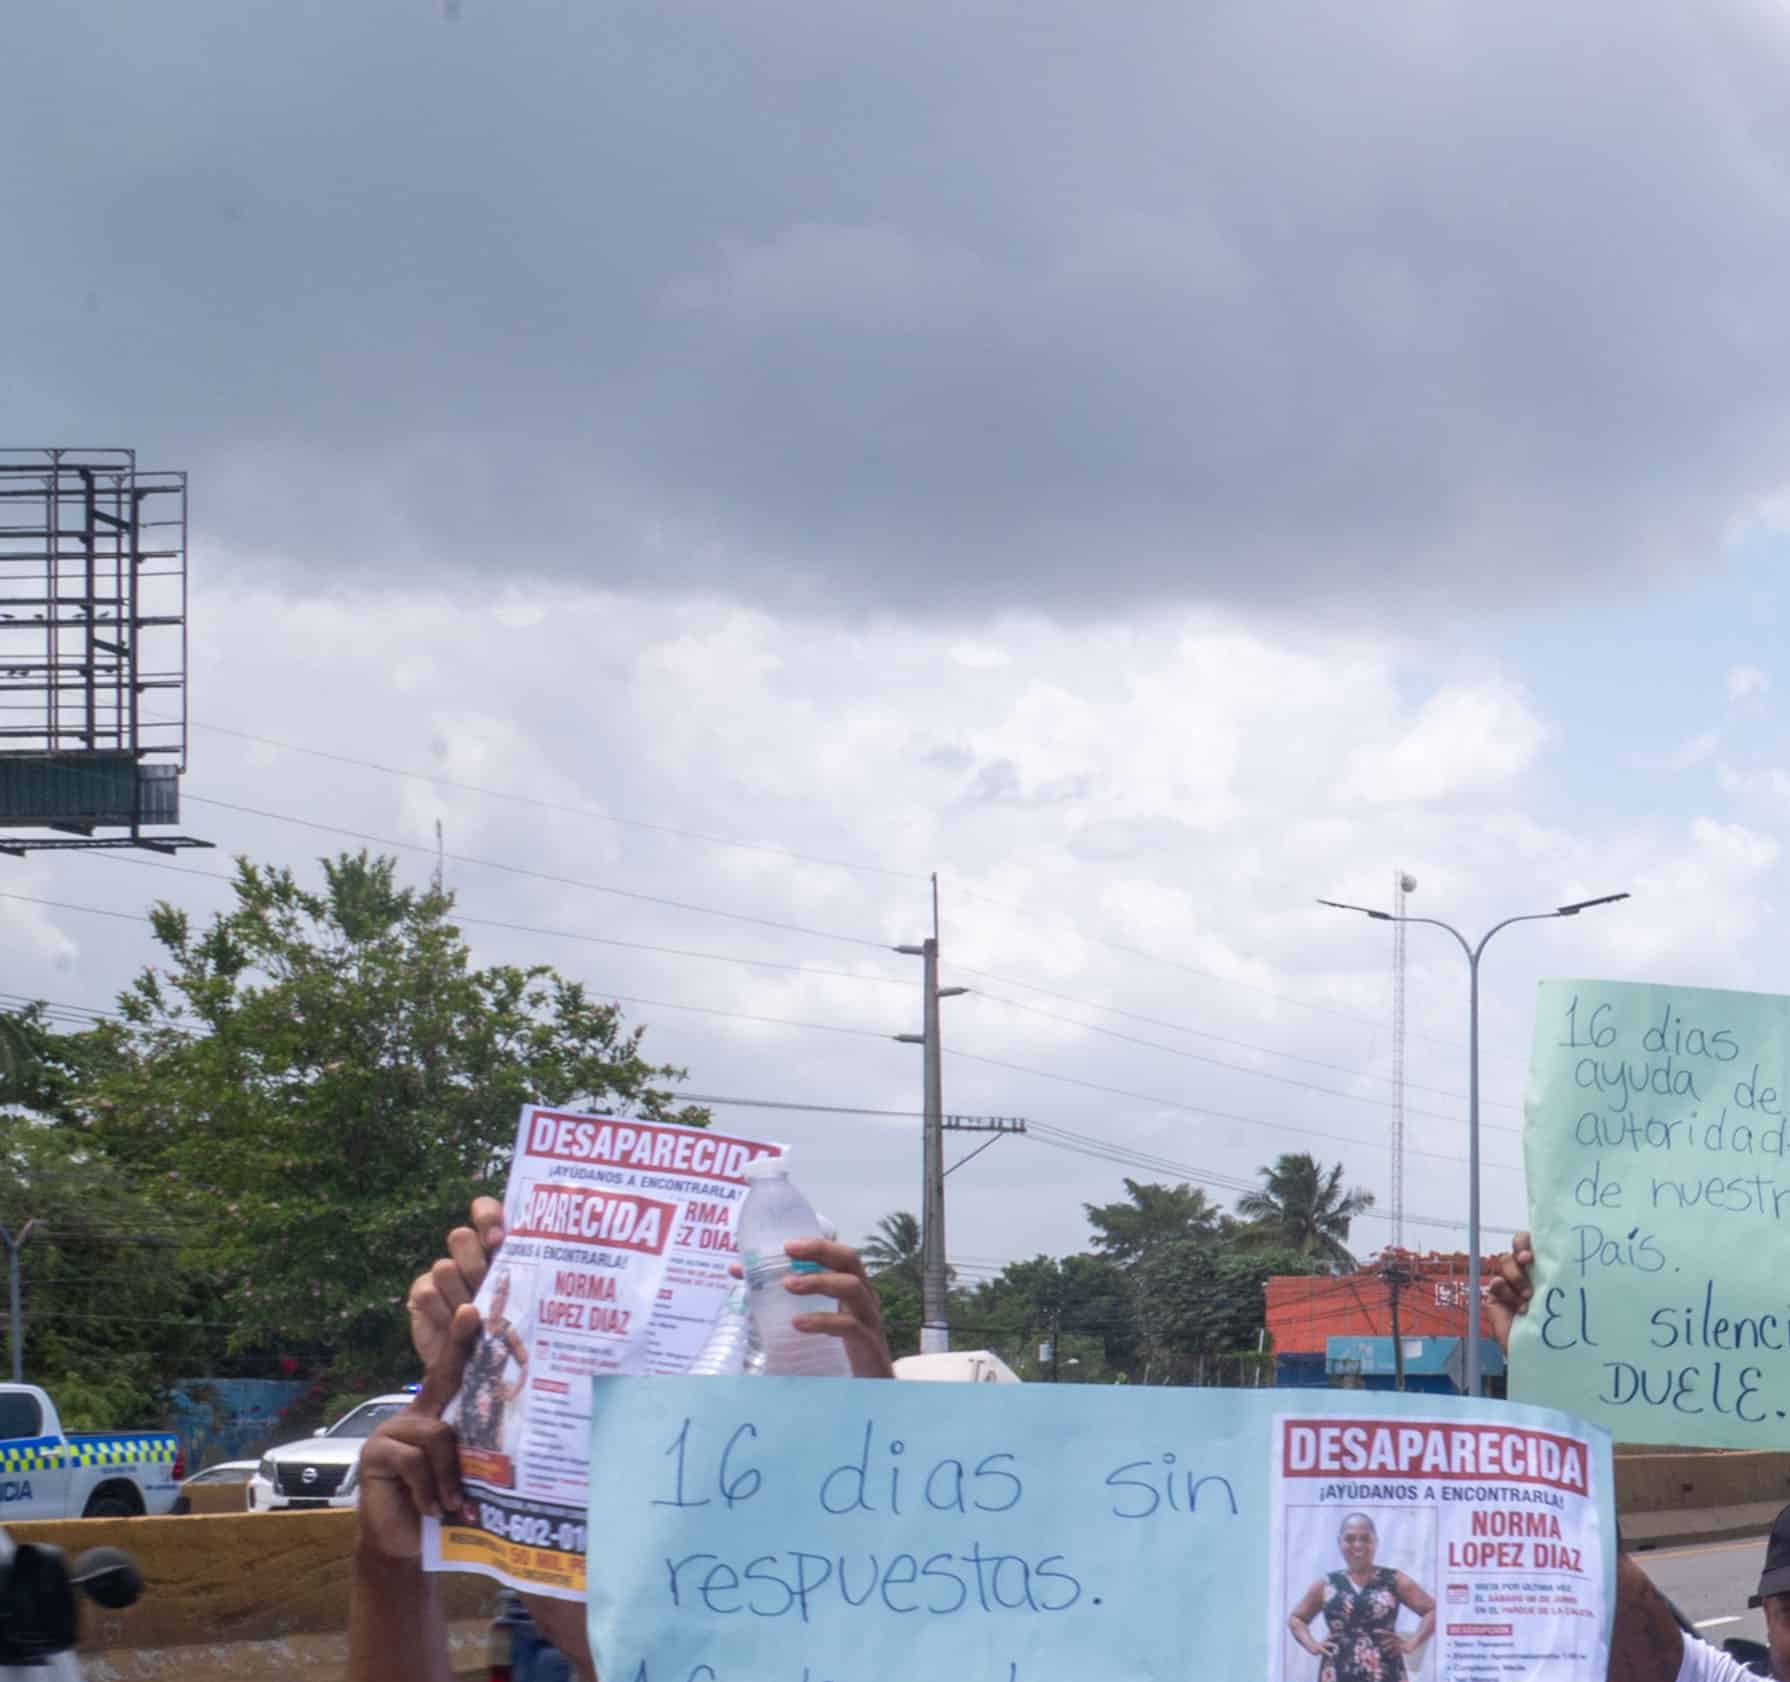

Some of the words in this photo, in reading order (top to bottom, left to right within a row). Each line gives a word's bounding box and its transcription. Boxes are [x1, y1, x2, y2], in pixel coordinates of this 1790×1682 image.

[1558, 994, 1616, 1048] 16
[1642, 1003, 1739, 1061] dias
[1575, 1056, 1701, 1112] ayuda
[1734, 1064, 1782, 1115] de
[531, 1116, 768, 1179] DESAPARECID
[1575, 1160, 1622, 1208] de
[555, 1270, 616, 1303] NORMA
[537, 1299, 583, 1328] LOPEZ
[589, 1306, 632, 1336] DIAZ
[1541, 1287, 1599, 1350] El
[650, 1417, 762, 1510] 16
[819, 1419, 1022, 1515] dias
[1105, 1454, 1239, 1518] sin
[1289, 1426, 1585, 1488] DESAPARECIDA
[1319, 1482, 1418, 1502] ¡AYÚDANOS
[1424, 1486, 1436, 1501] A
[1441, 1485, 1564, 1511] ENCONTRARLA!
[1471, 1510, 1562, 1541] NORMA
[664, 1541, 1103, 1624] respuestas.
[1447, 1541, 1524, 1568] LOPEZ
[1533, 1545, 1584, 1573] DIAZ
